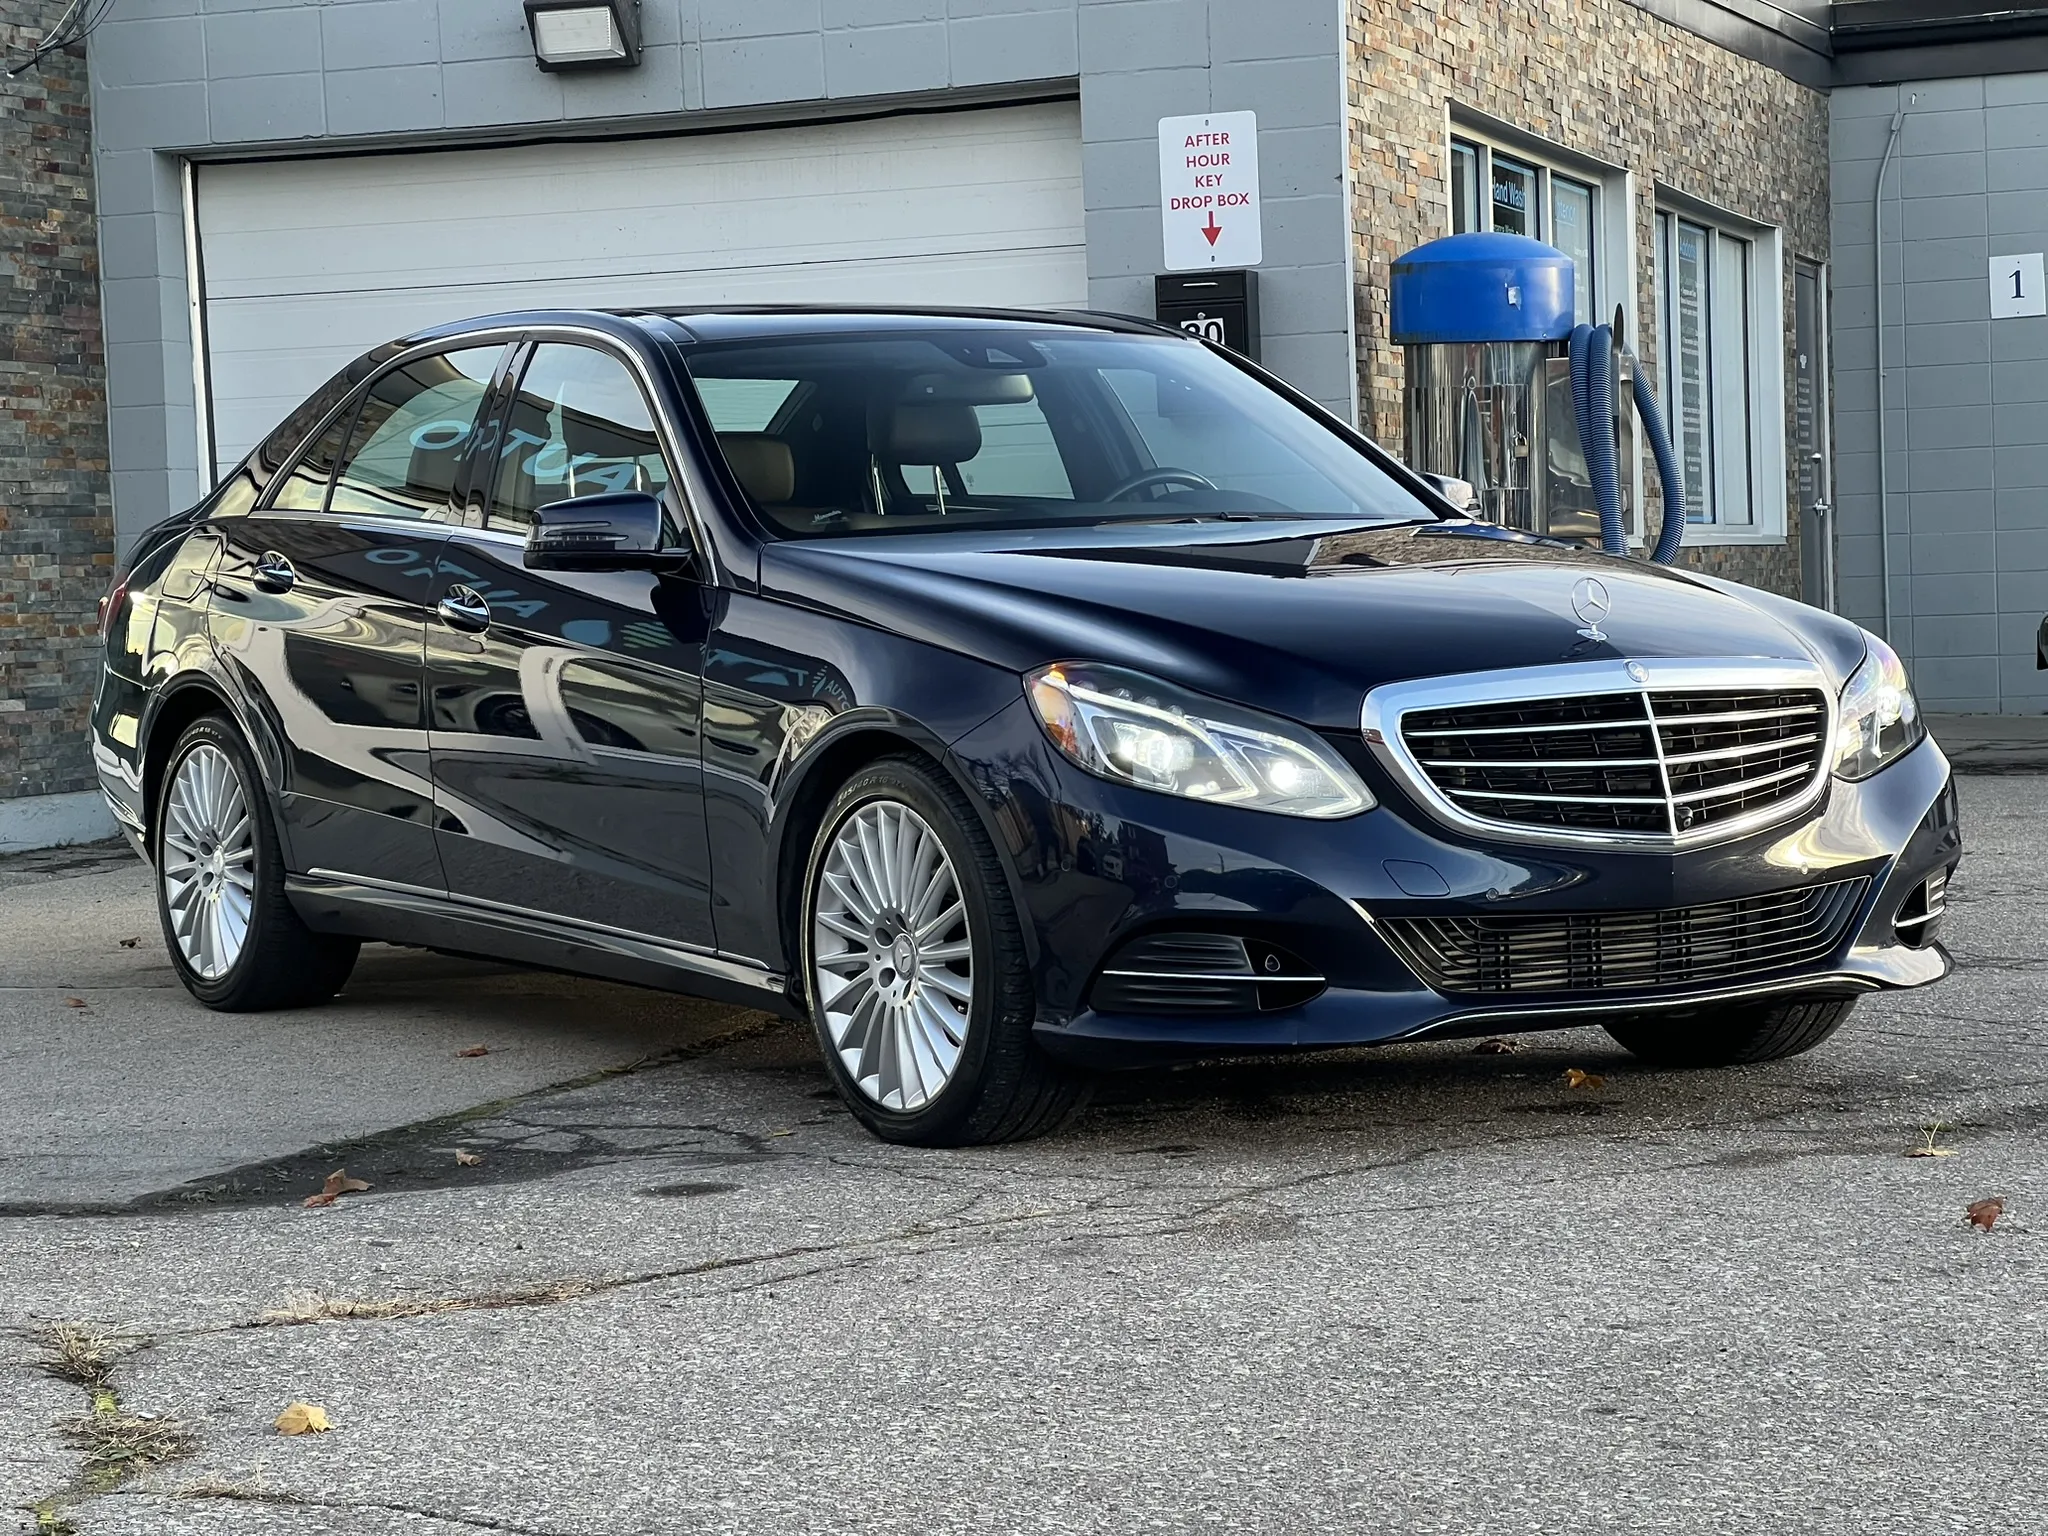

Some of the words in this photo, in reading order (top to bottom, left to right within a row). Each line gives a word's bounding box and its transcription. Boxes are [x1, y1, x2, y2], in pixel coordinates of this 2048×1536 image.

[1184, 132, 1230, 148] AFTER
[1186, 153, 1231, 168] HOUR
[1195, 173, 1223, 188] KEY
[1170, 196, 1213, 211] DROP
[1217, 192, 1250, 207] BOX
[2008, 269, 2025, 299] 1
